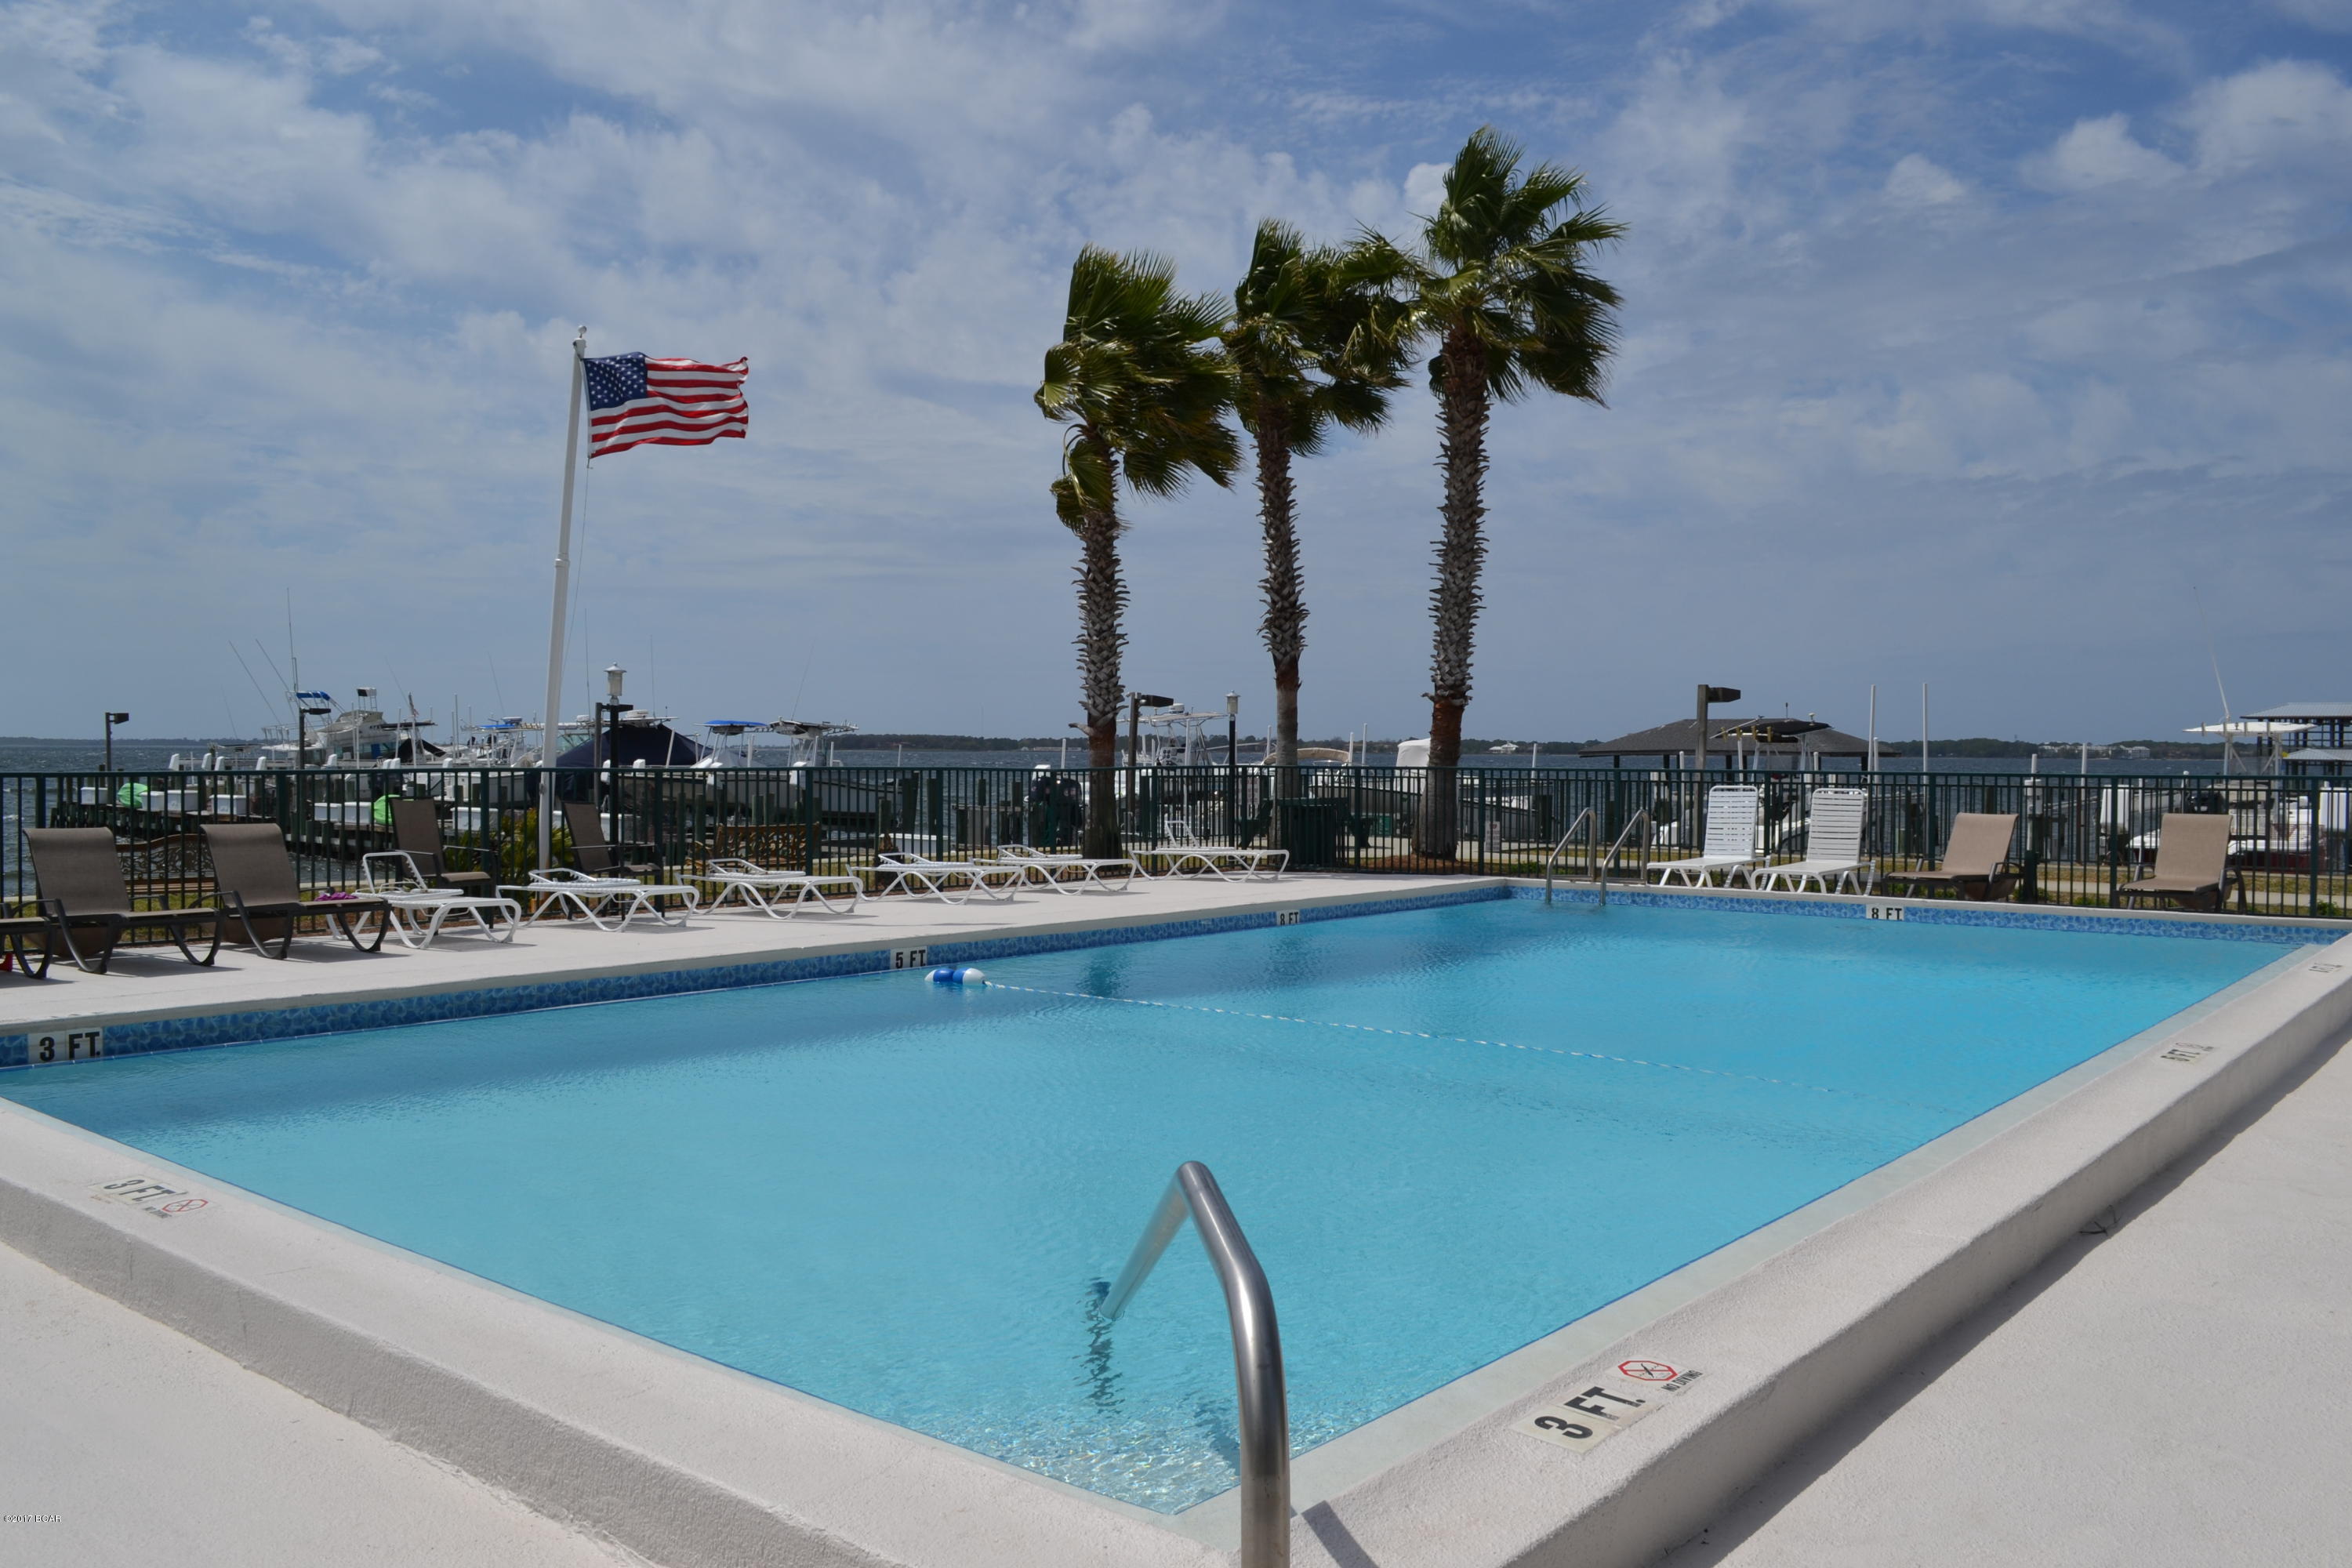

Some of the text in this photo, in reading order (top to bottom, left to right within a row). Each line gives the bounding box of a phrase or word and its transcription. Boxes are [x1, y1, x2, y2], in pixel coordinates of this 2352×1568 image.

[1279, 913, 1285, 925] 8
[1871, 907, 1879, 920] 8
[895, 952, 903, 969] 5
[39, 1031, 101, 1062] 3 FT.
[103, 1179, 145, 1189] 3
[1661, 1383, 1681, 1392] NO
[1534, 1385, 1646, 1439] 3 FT.
